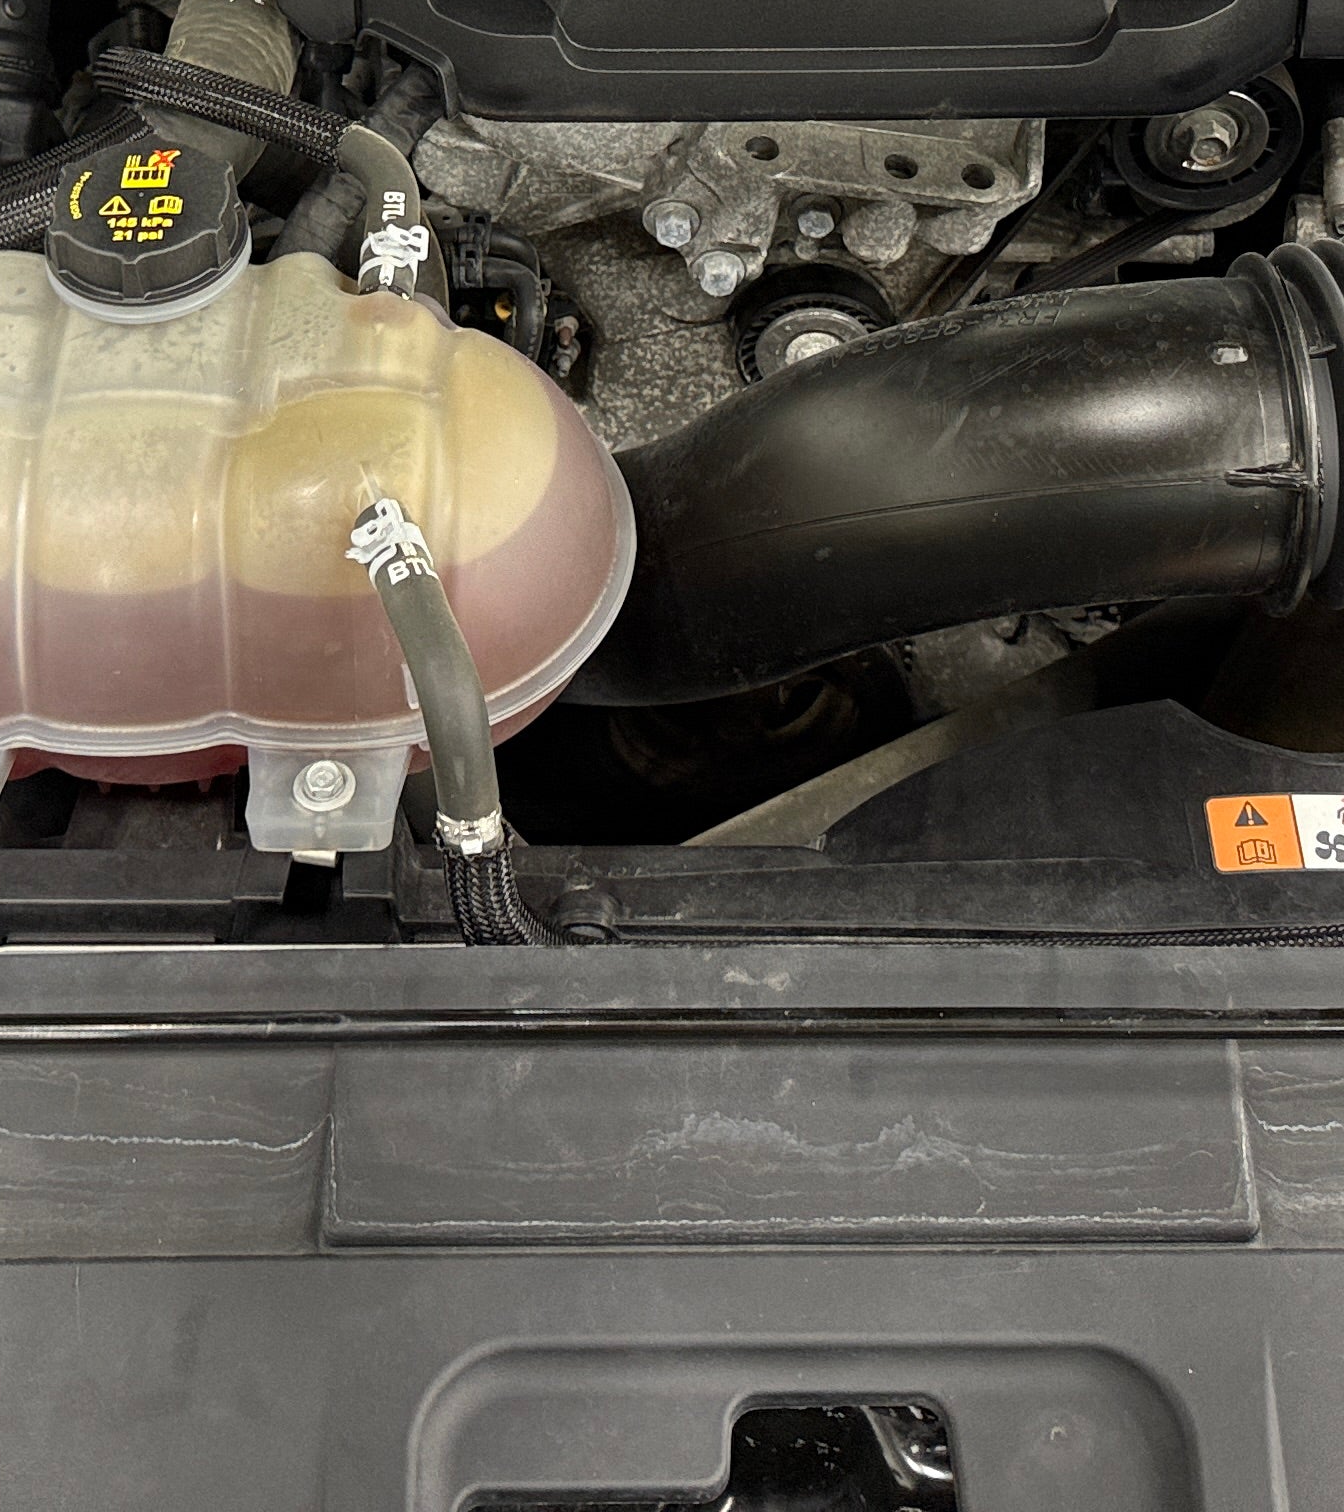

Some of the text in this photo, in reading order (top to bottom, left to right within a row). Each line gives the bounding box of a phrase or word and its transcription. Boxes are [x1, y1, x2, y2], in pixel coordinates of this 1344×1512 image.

[107, 216, 173, 229] 145 kPa
[112, 228, 164, 243] 21 psi
